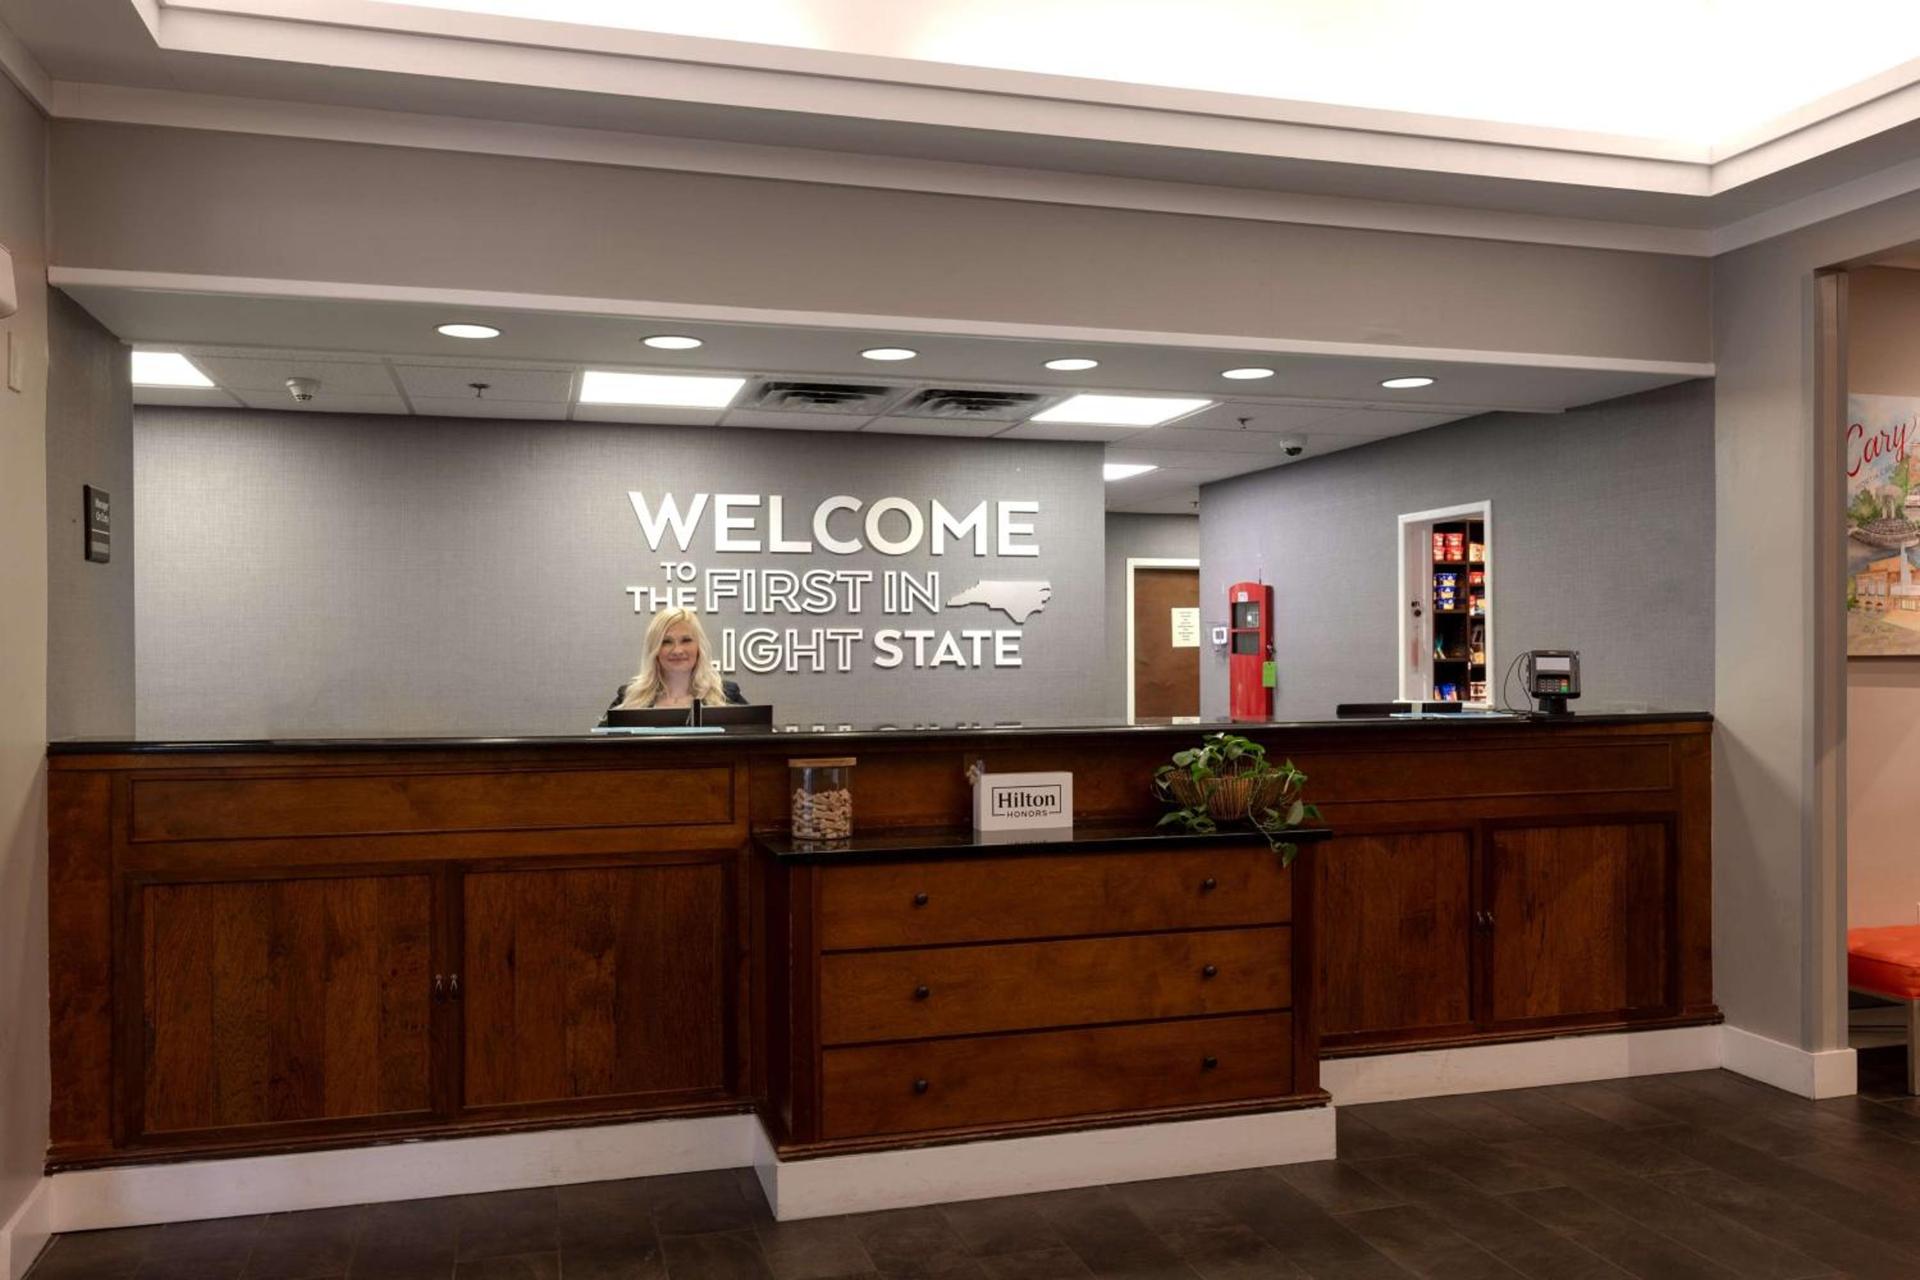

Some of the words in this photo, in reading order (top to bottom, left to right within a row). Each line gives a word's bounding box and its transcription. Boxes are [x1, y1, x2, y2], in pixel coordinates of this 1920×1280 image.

[1846, 423, 1906, 477] Cary
[627, 491, 1040, 557] WELCOME
[626, 586, 697, 613] THE
[705, 568, 873, 613] FIRST
[884, 570, 940, 613] IN
[660, 561, 697, 582] TO
[873, 629, 1022, 669] STATE
[998, 791, 1056, 808] Hilton
[1006, 809, 1049, 818] HONORS
